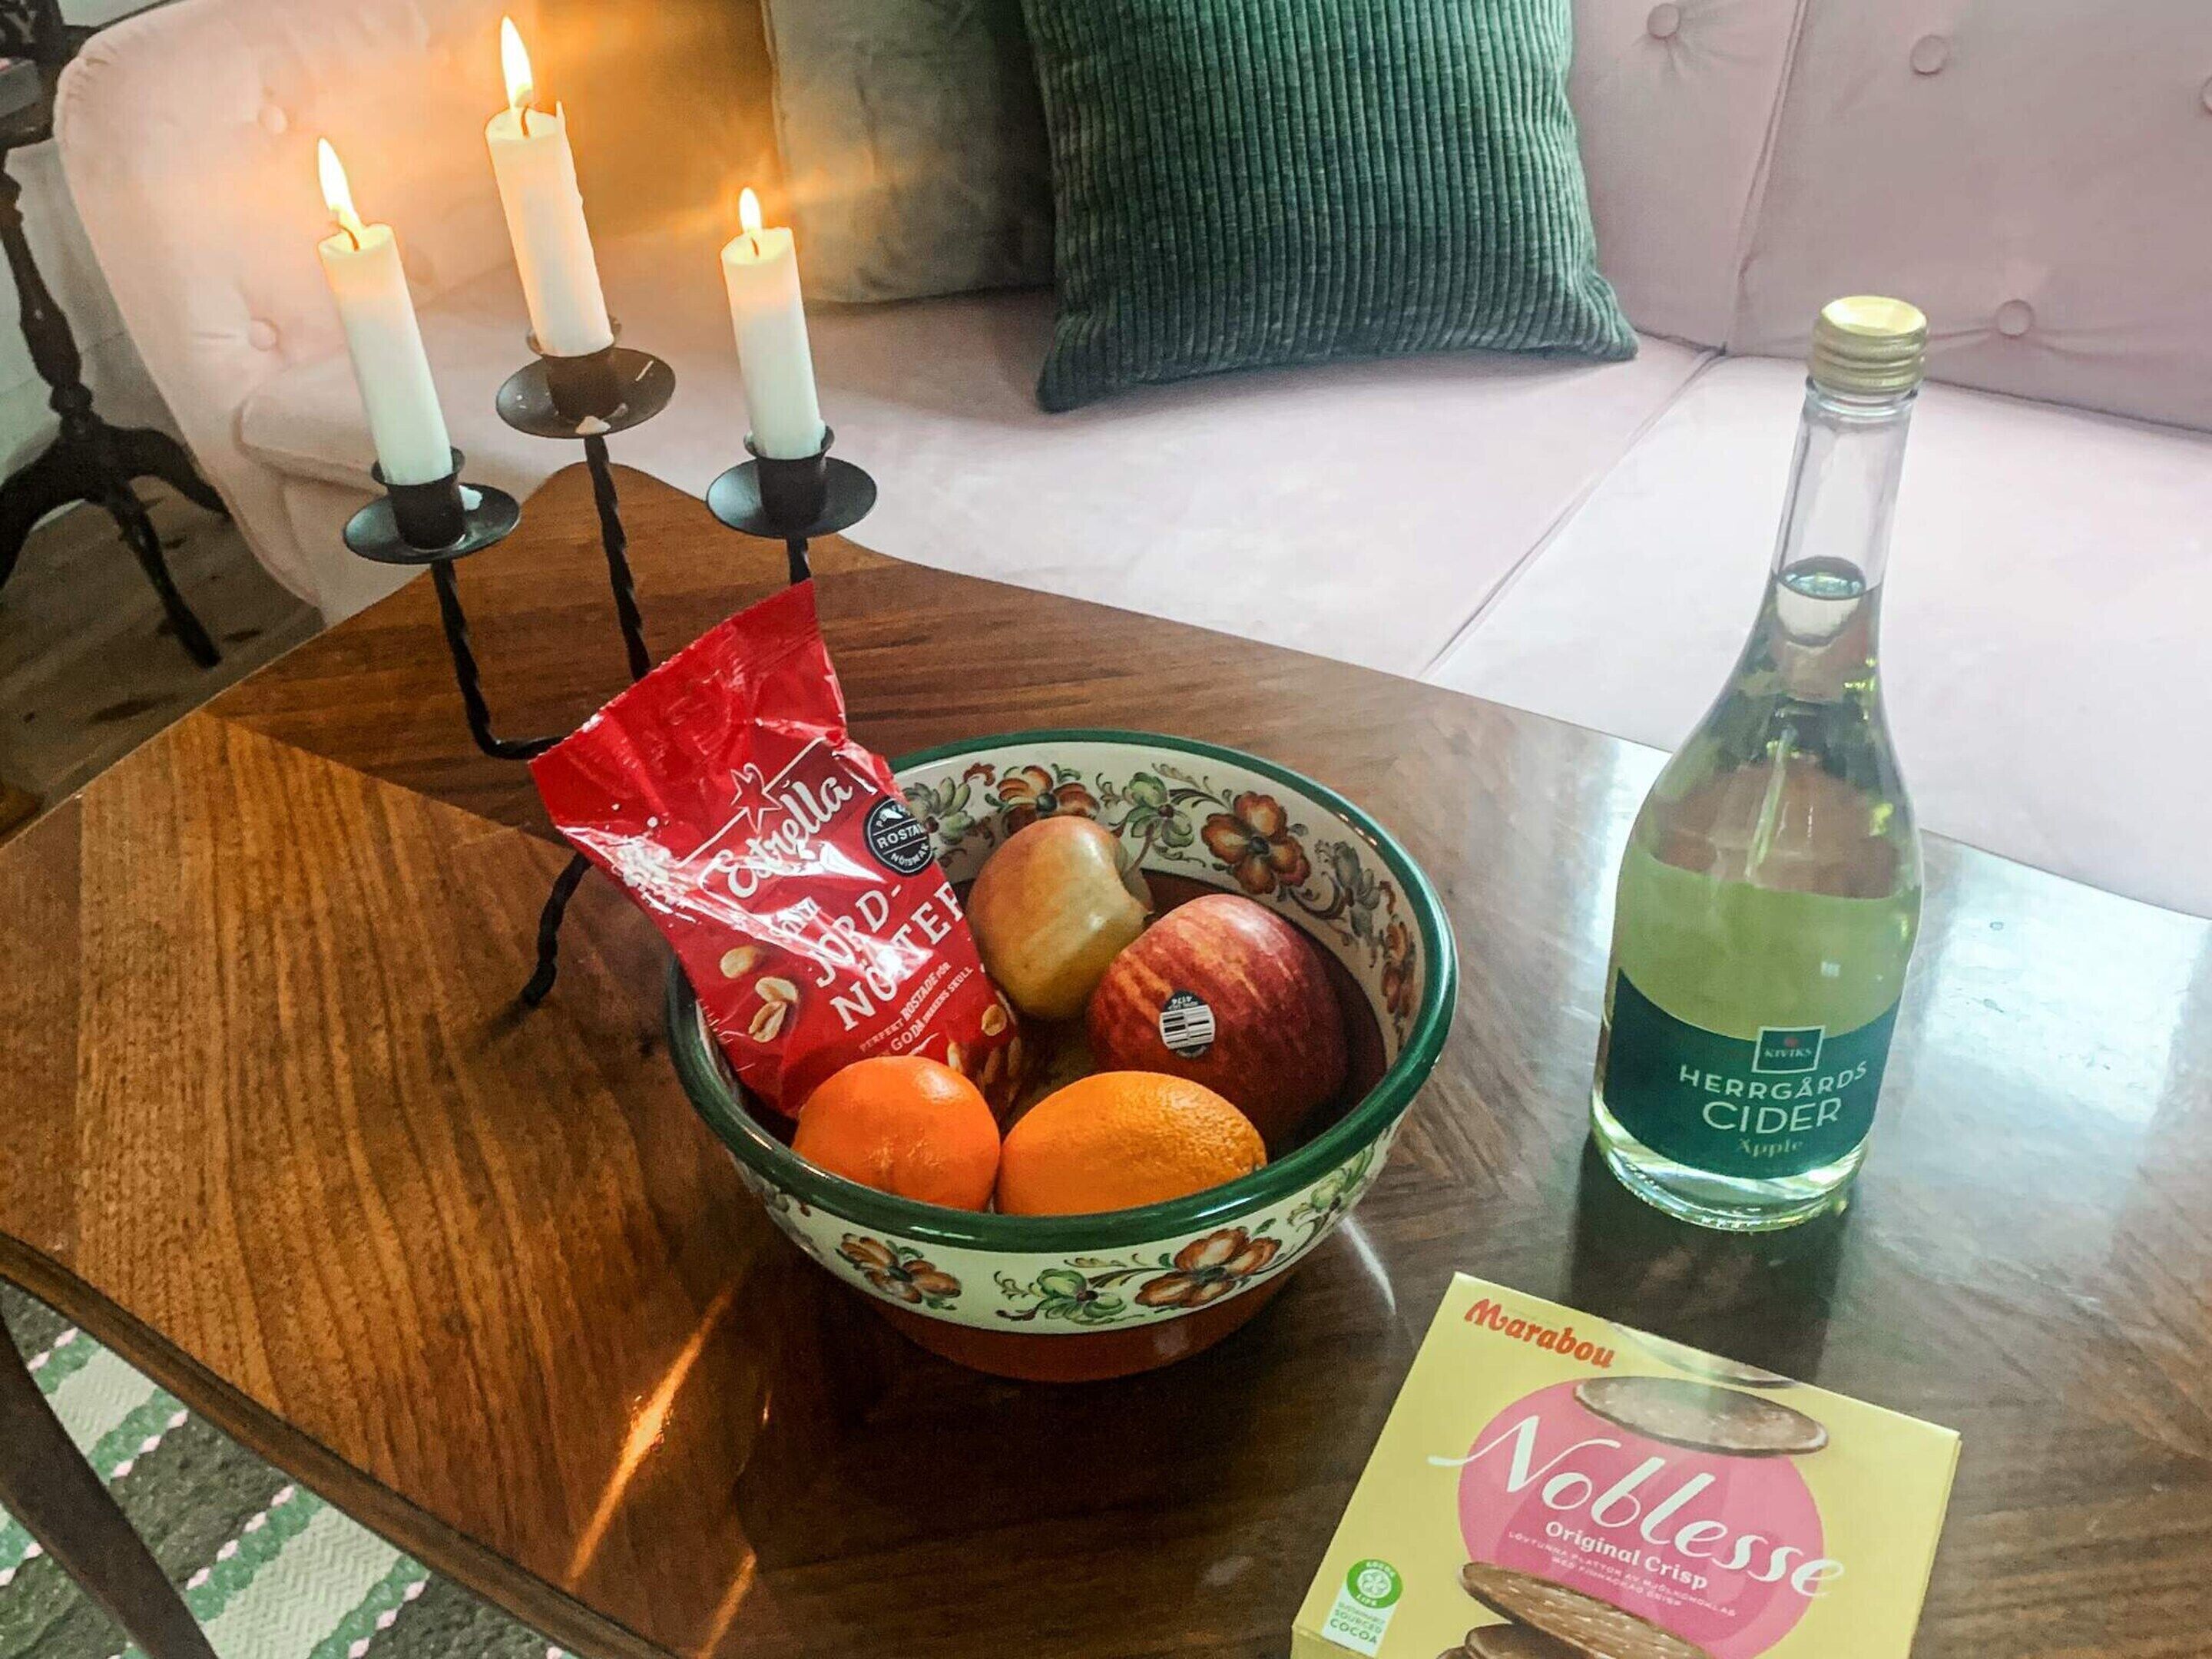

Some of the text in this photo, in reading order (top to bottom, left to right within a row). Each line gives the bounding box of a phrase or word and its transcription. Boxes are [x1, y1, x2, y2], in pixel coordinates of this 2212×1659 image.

[705, 777, 853, 899] Estrella
[816, 883, 902, 988] JORD-
[859, 1018, 905, 1052] PERFEKT
[900, 972, 938, 1022] ROSTADE
[890, 1018, 926, 1051] GODA
[946, 966, 974, 993] SKULL
[1679, 1060, 1868, 1101] HERRGÅRDS
[1702, 1097, 1842, 1134] CIDER
[1737, 1137, 1804, 1158] Äpple
[1464, 1298, 1616, 1369] Marabou
[1428, 1414, 1845, 1598] Noblesse
[1545, 1521, 1708, 1591] Original Crisp
[1330, 1618, 1377, 1645] COCOA
